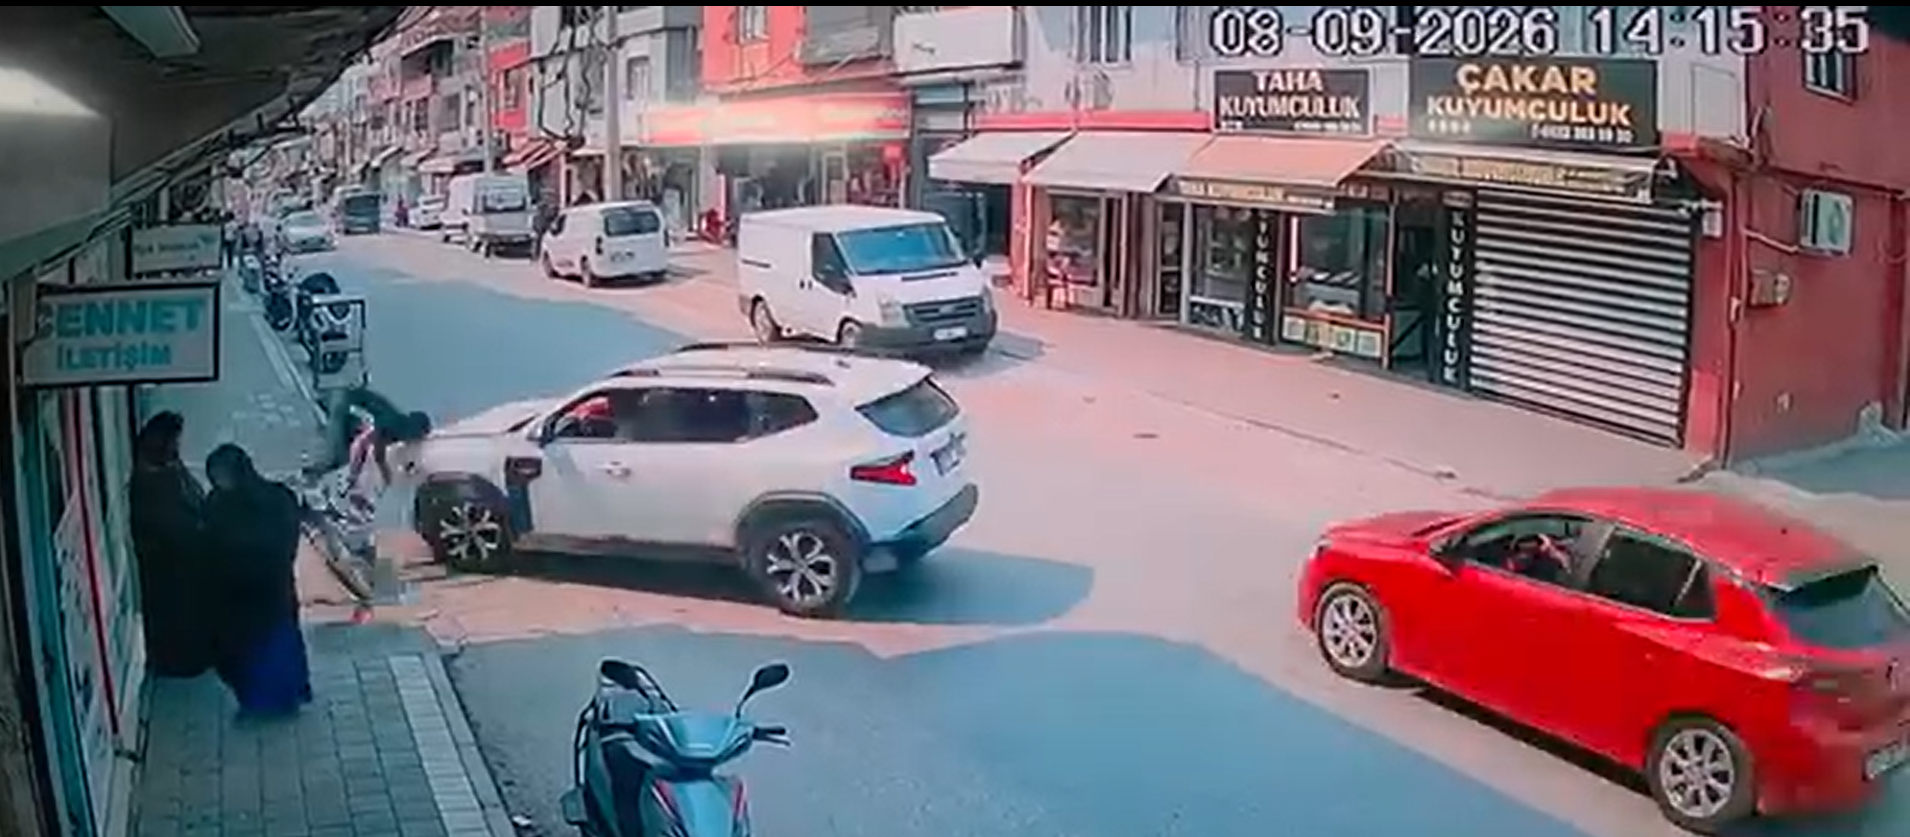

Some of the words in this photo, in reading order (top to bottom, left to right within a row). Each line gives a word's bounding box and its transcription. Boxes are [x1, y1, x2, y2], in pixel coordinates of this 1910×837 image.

[1253, 71, 1324, 92] TAHA
[1456, 63, 1597, 95] ÇAKAR
[1219, 95, 1361, 118] KUYUMCULUK
[1427, 96, 1631, 126] KUYUMCULUK
